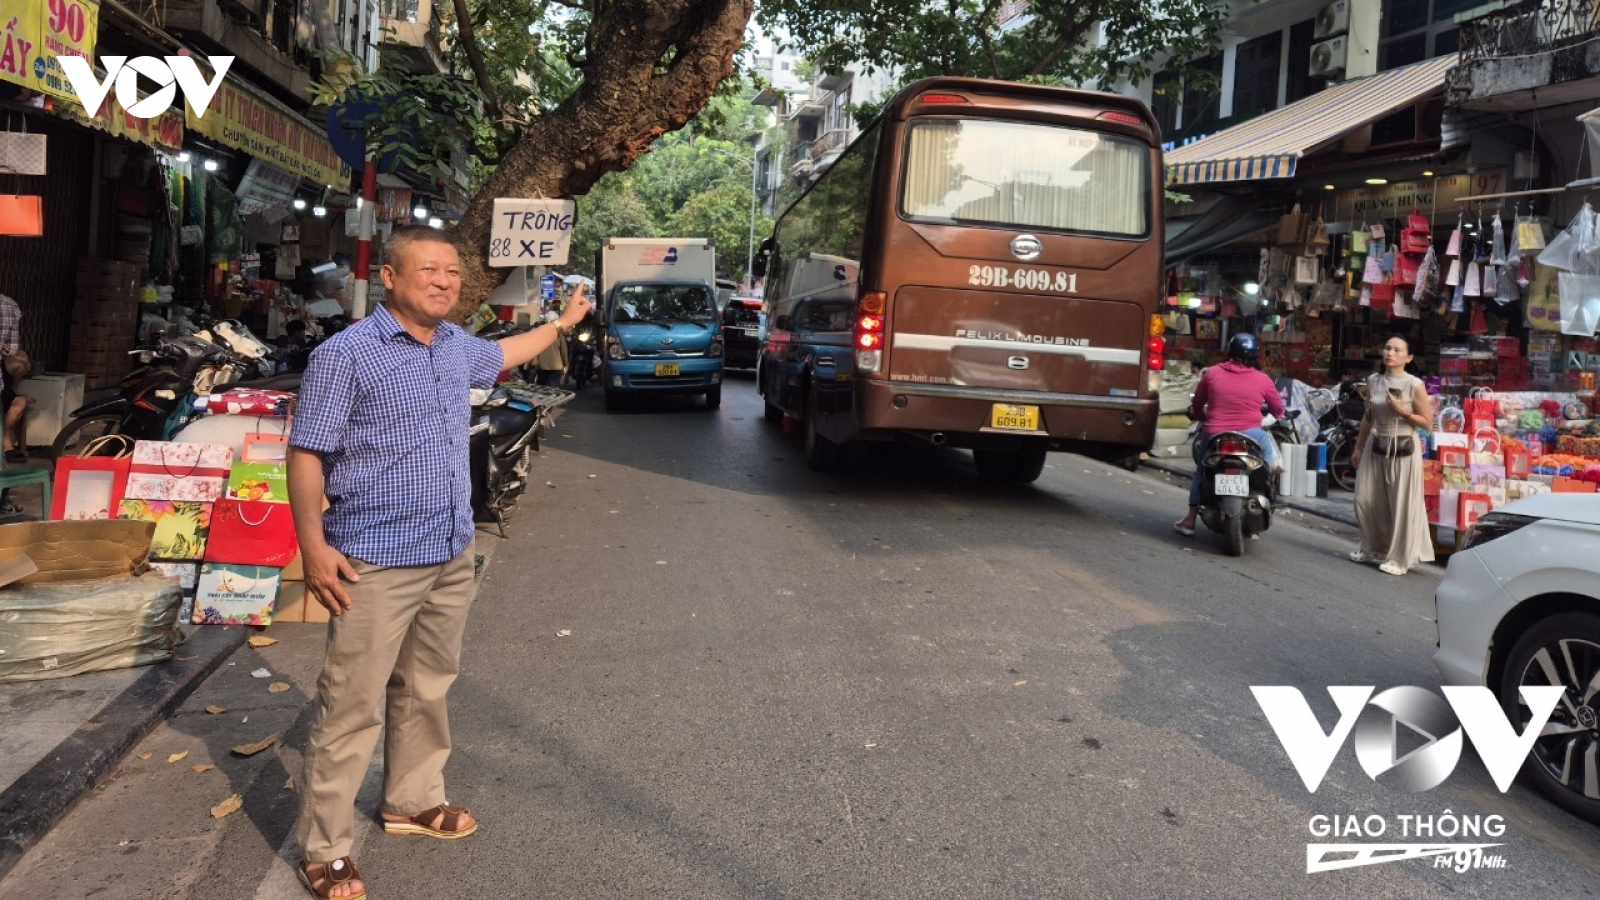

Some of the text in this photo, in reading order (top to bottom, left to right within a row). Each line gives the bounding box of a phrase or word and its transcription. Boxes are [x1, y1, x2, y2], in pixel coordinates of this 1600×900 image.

[48, 0, 85, 43] 90
[0, 16, 32, 78] ẤY
[1477, 176, 1499, 195] 97
[502, 209, 574, 231] TRÔNG
[490, 237, 555, 258] 88 XE
[968, 264, 1079, 294] 29B-609.81
[955, 329, 1090, 347] FELIX LIMOUSINE
[890, 373, 960, 385] www.hmt.com.v
[996, 416, 1032, 428] 609.81
